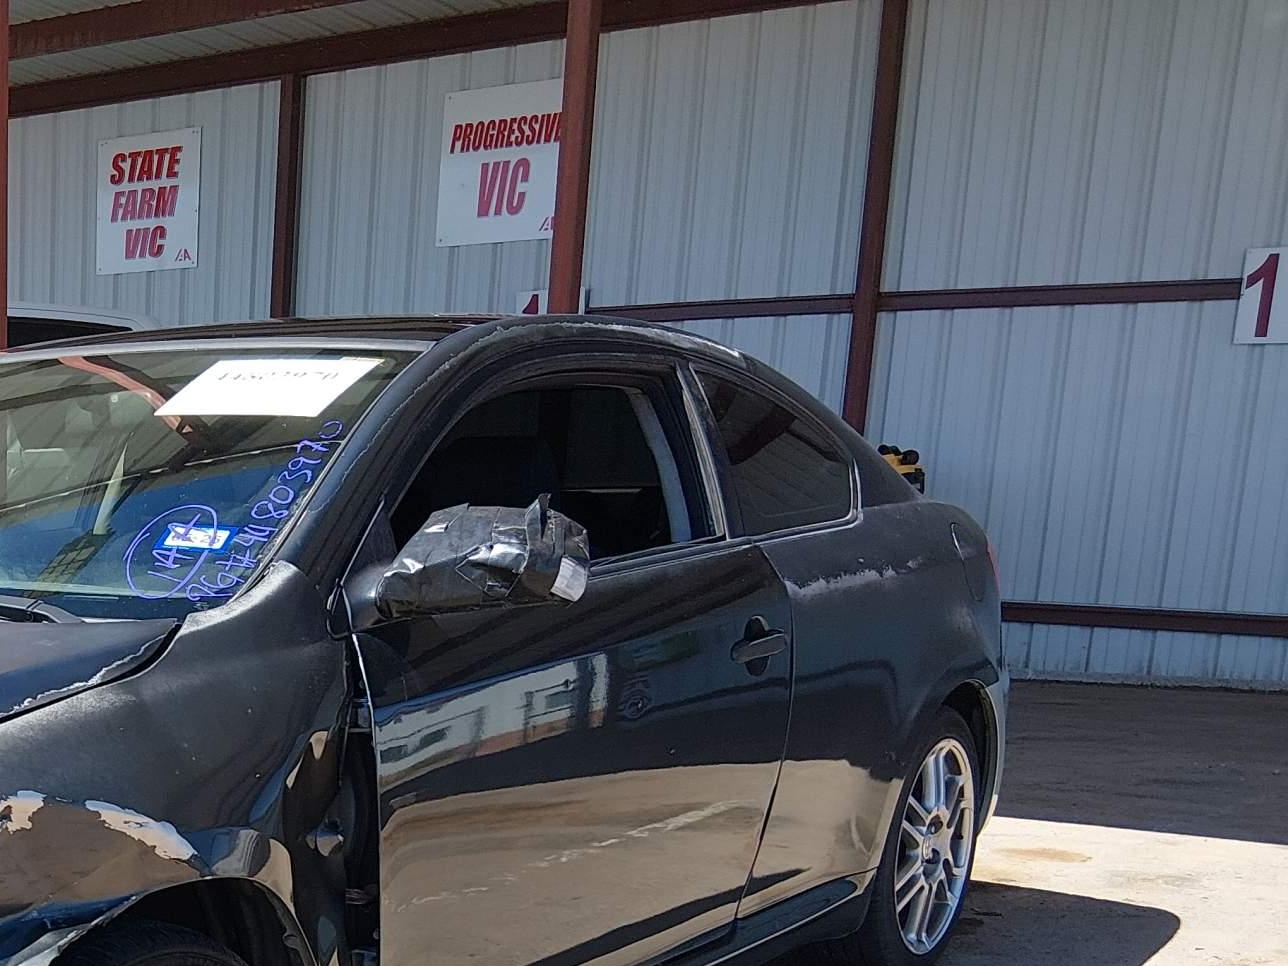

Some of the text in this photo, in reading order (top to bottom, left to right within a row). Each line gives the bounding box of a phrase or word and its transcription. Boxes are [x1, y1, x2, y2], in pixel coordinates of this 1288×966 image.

[109, 145, 183, 186] STATE
[110, 184, 179, 224] FARM
[477, 157, 531, 218] VIC
[124, 225, 167, 261] VIC
